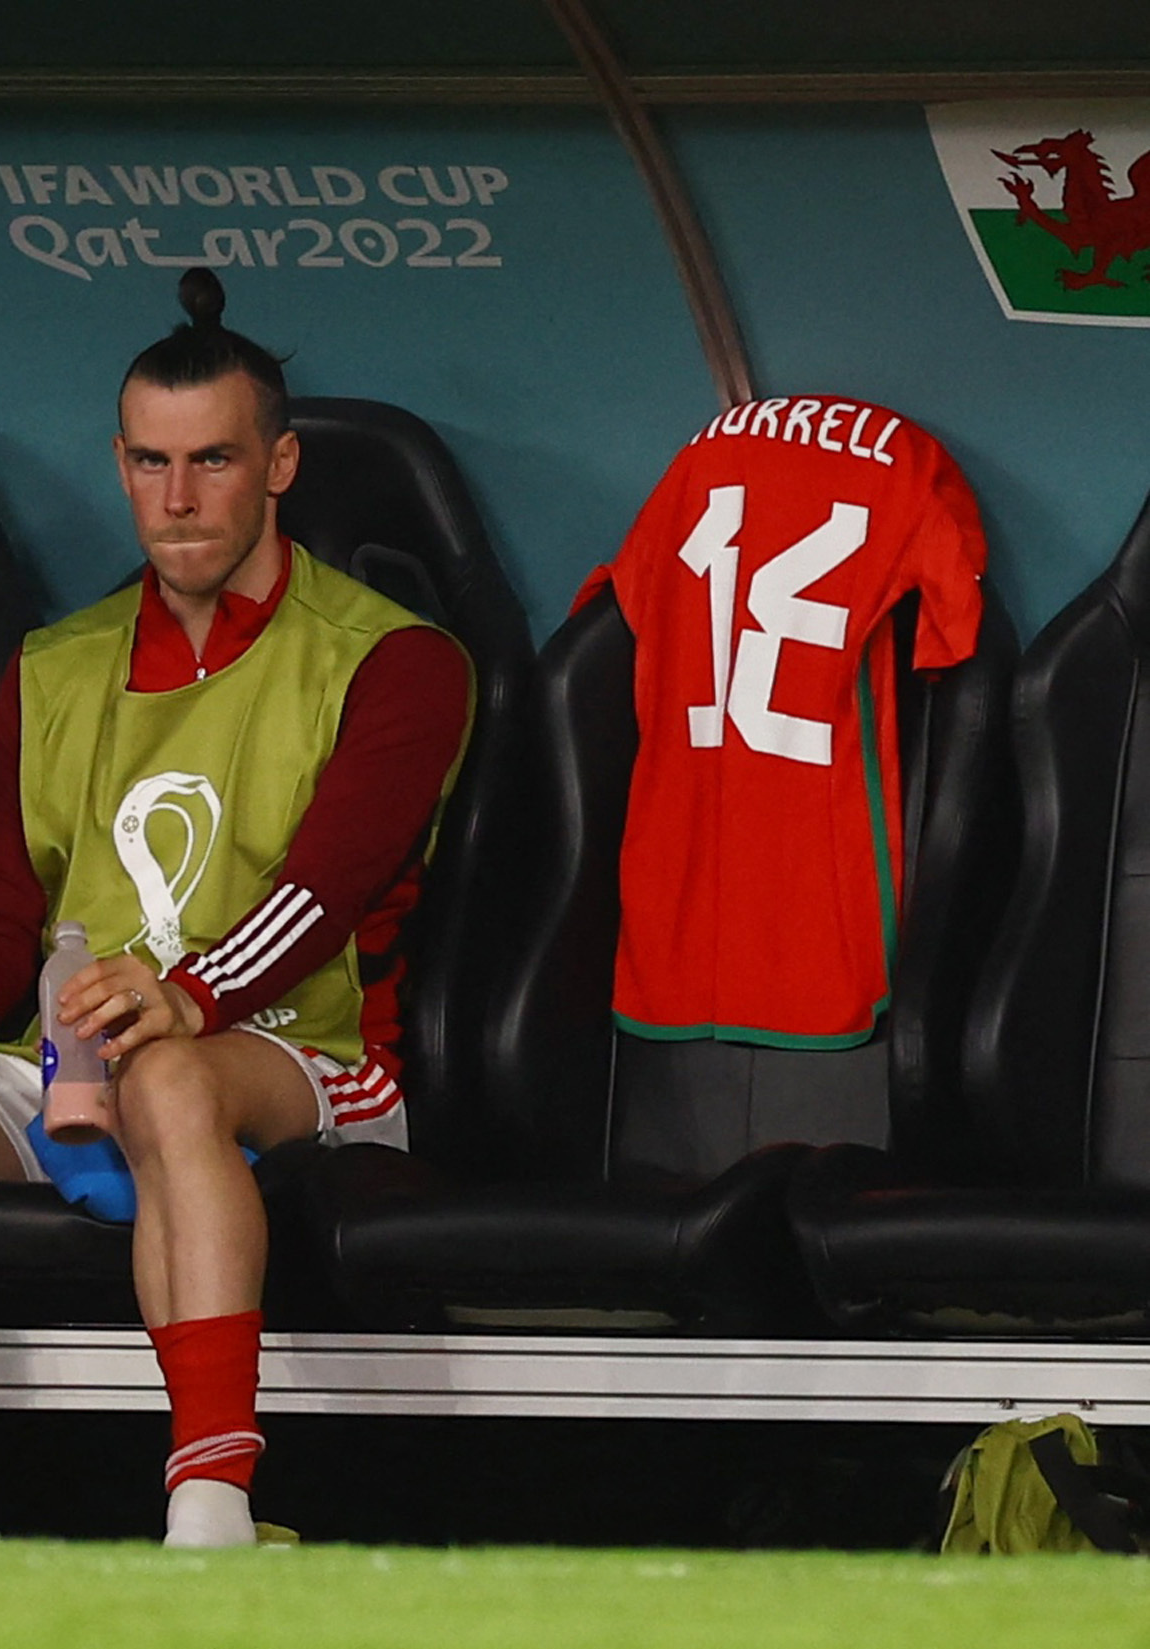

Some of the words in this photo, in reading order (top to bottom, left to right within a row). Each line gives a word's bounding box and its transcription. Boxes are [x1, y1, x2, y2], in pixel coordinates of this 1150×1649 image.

[109, 165, 367, 207] WORLD
[377, 165, 509, 207] CUP
[252, 1008, 298, 1029] UP
